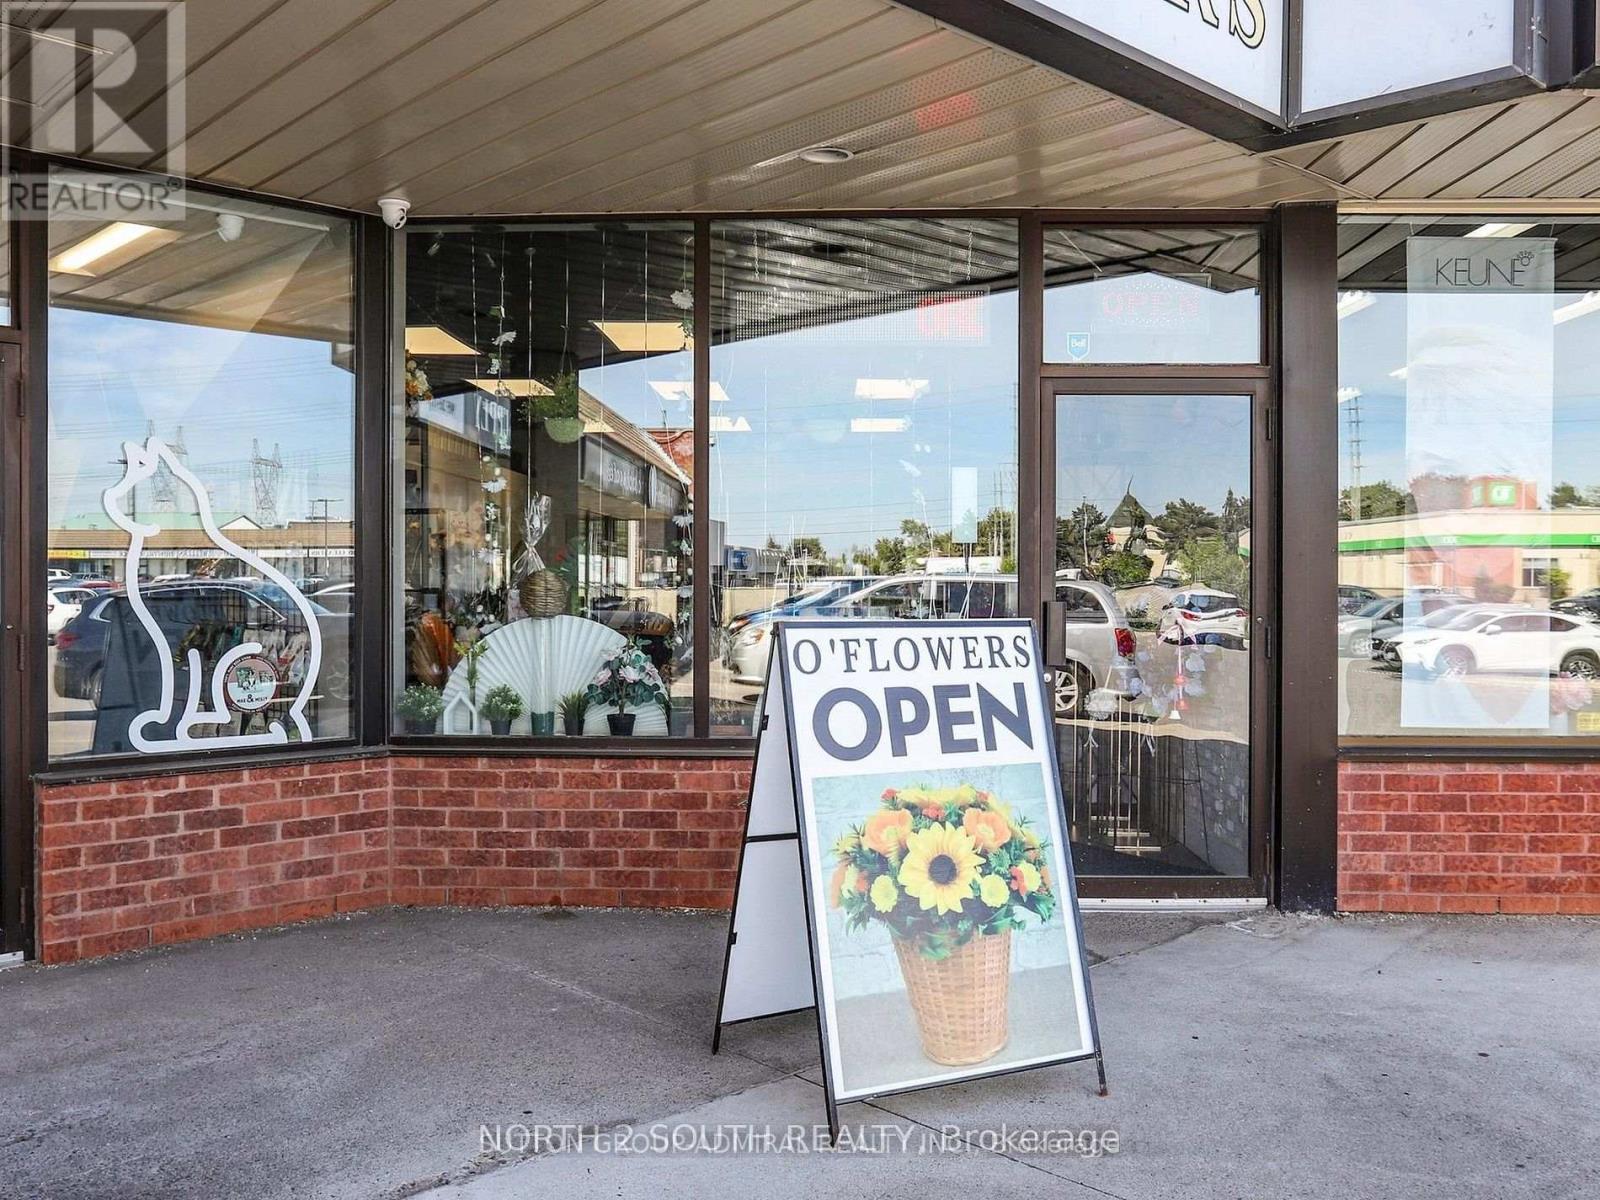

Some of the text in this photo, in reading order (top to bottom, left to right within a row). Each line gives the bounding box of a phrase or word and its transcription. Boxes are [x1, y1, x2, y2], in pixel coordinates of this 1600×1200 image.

[1435, 257, 1525, 287] KEUNE
[793, 635, 1031, 675] O'FLOWERS
[812, 681, 1034, 762] OPEN
